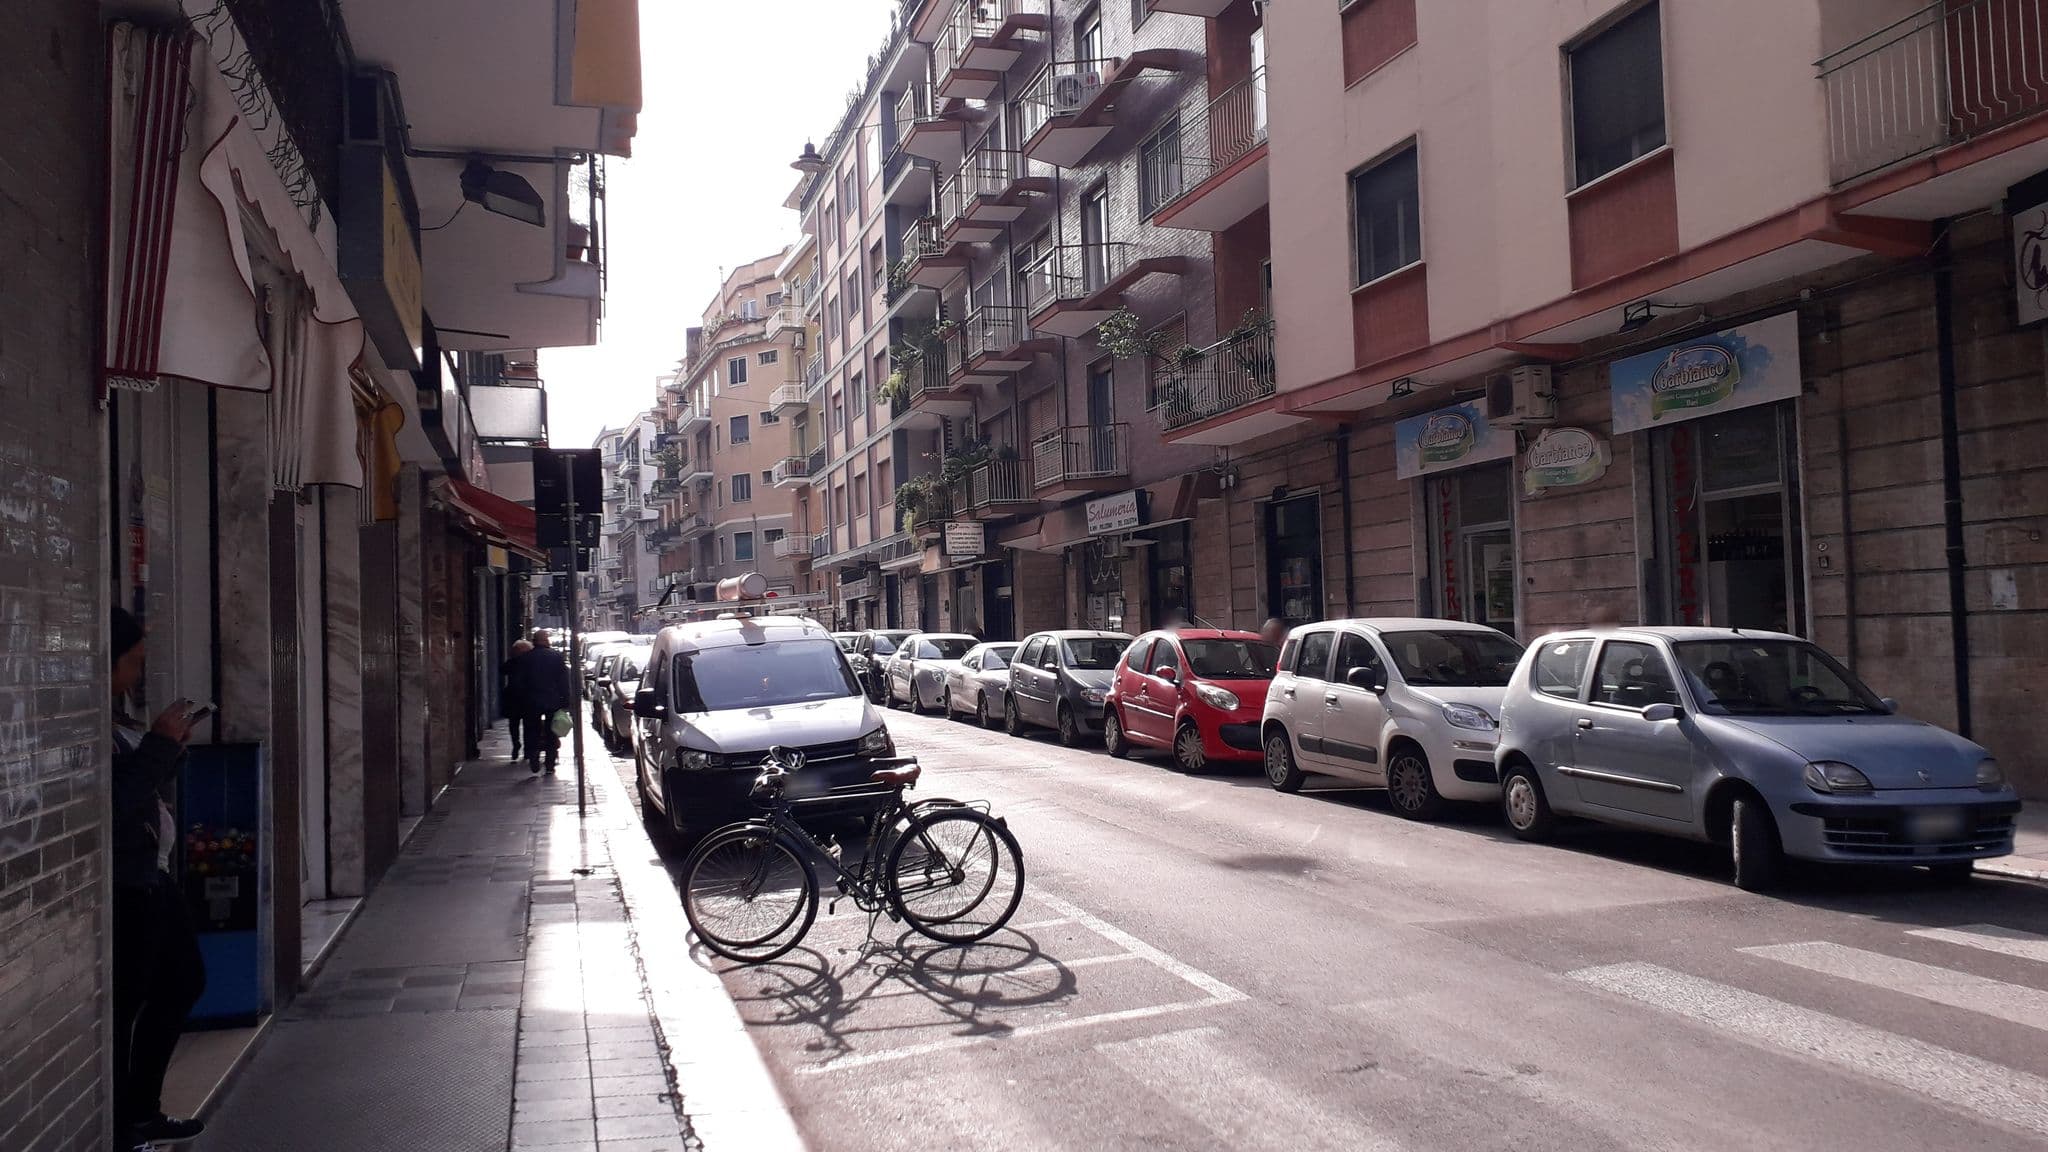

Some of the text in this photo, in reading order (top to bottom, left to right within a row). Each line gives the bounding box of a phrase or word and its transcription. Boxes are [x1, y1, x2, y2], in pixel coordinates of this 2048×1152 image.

[1658, 362, 1725, 389] barbianco
[1531, 441, 1591, 467] barbianco
[1088, 499, 1137, 523] Salumeria
